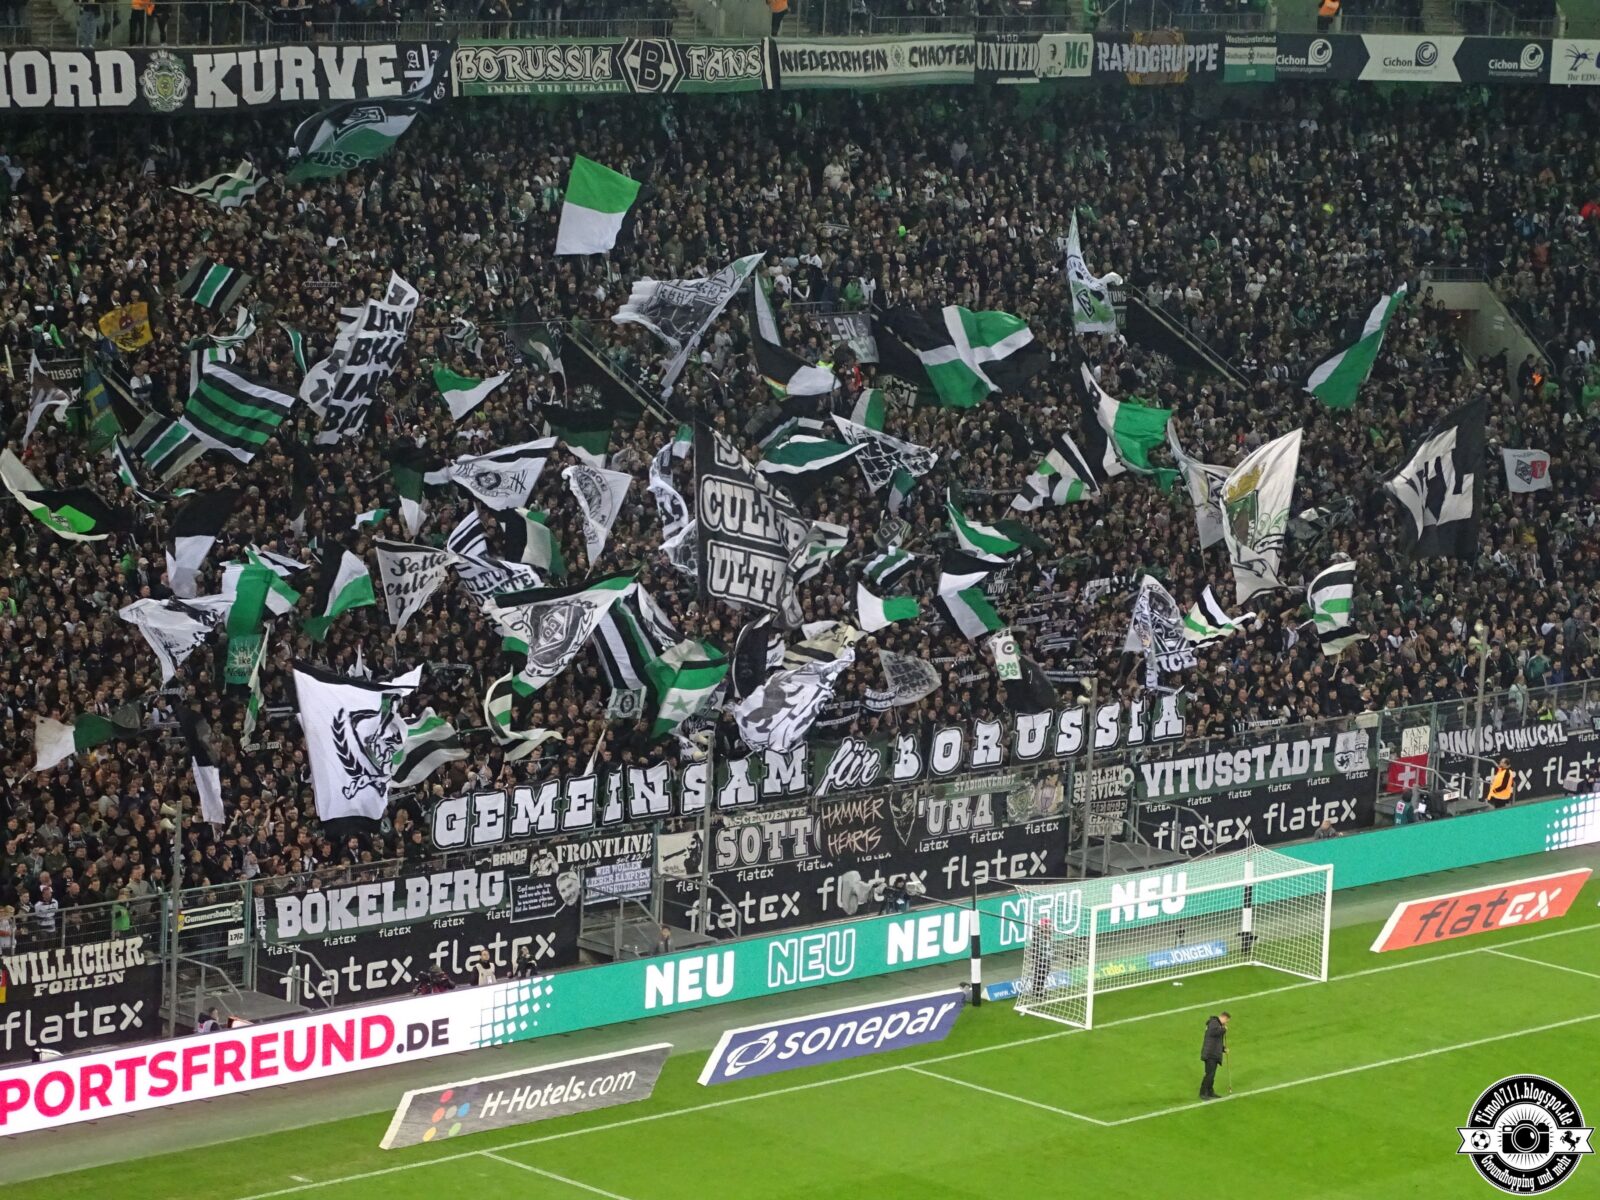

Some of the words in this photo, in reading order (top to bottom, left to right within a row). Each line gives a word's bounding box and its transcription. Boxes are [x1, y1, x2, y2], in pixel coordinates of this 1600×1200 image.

[456, 46, 613, 82] BORUSSIA
[688, 46, 762, 82] FANS
[780, 48, 889, 73] NIEDERRHEIN
[908, 43, 974, 69] CHAOTEN
[976, 42, 1039, 70] UNITED
[1064, 41, 1089, 69] MG
[1276, 55, 1306, 65] Cichon
[1383, 57, 1413, 67] Cichon
[1488, 59, 1518, 70] Cichon
[0, 50, 136, 107] ORD
[193, 44, 402, 108] KURVE
[1494, 722, 1568, 752] PUMUCKL
[432, 741, 808, 850] GEMEINSAM
[815, 736, 882, 796] für
[893, 689, 1186, 782] BORUSSIA
[1141, 736, 1331, 798] VITUSSTADT
[820, 797, 885, 829] HAMMER
[555, 832, 654, 865] FRONTLINE
[827, 826, 882, 857] HEARTS
[276, 868, 505, 939] BÖKELBERG
[1110, 871, 1187, 925] NEU
[887, 909, 971, 966] NEU
[2, 936, 145, 986] WILLICHER
[767, 928, 856, 988] NEU
[34, 970, 126, 997] FOHLEN
[645, 950, 735, 1010] NEU
[776, 999, 957, 1062] sonepar
[479, 1066, 636, 1119] H-Hotels.com
